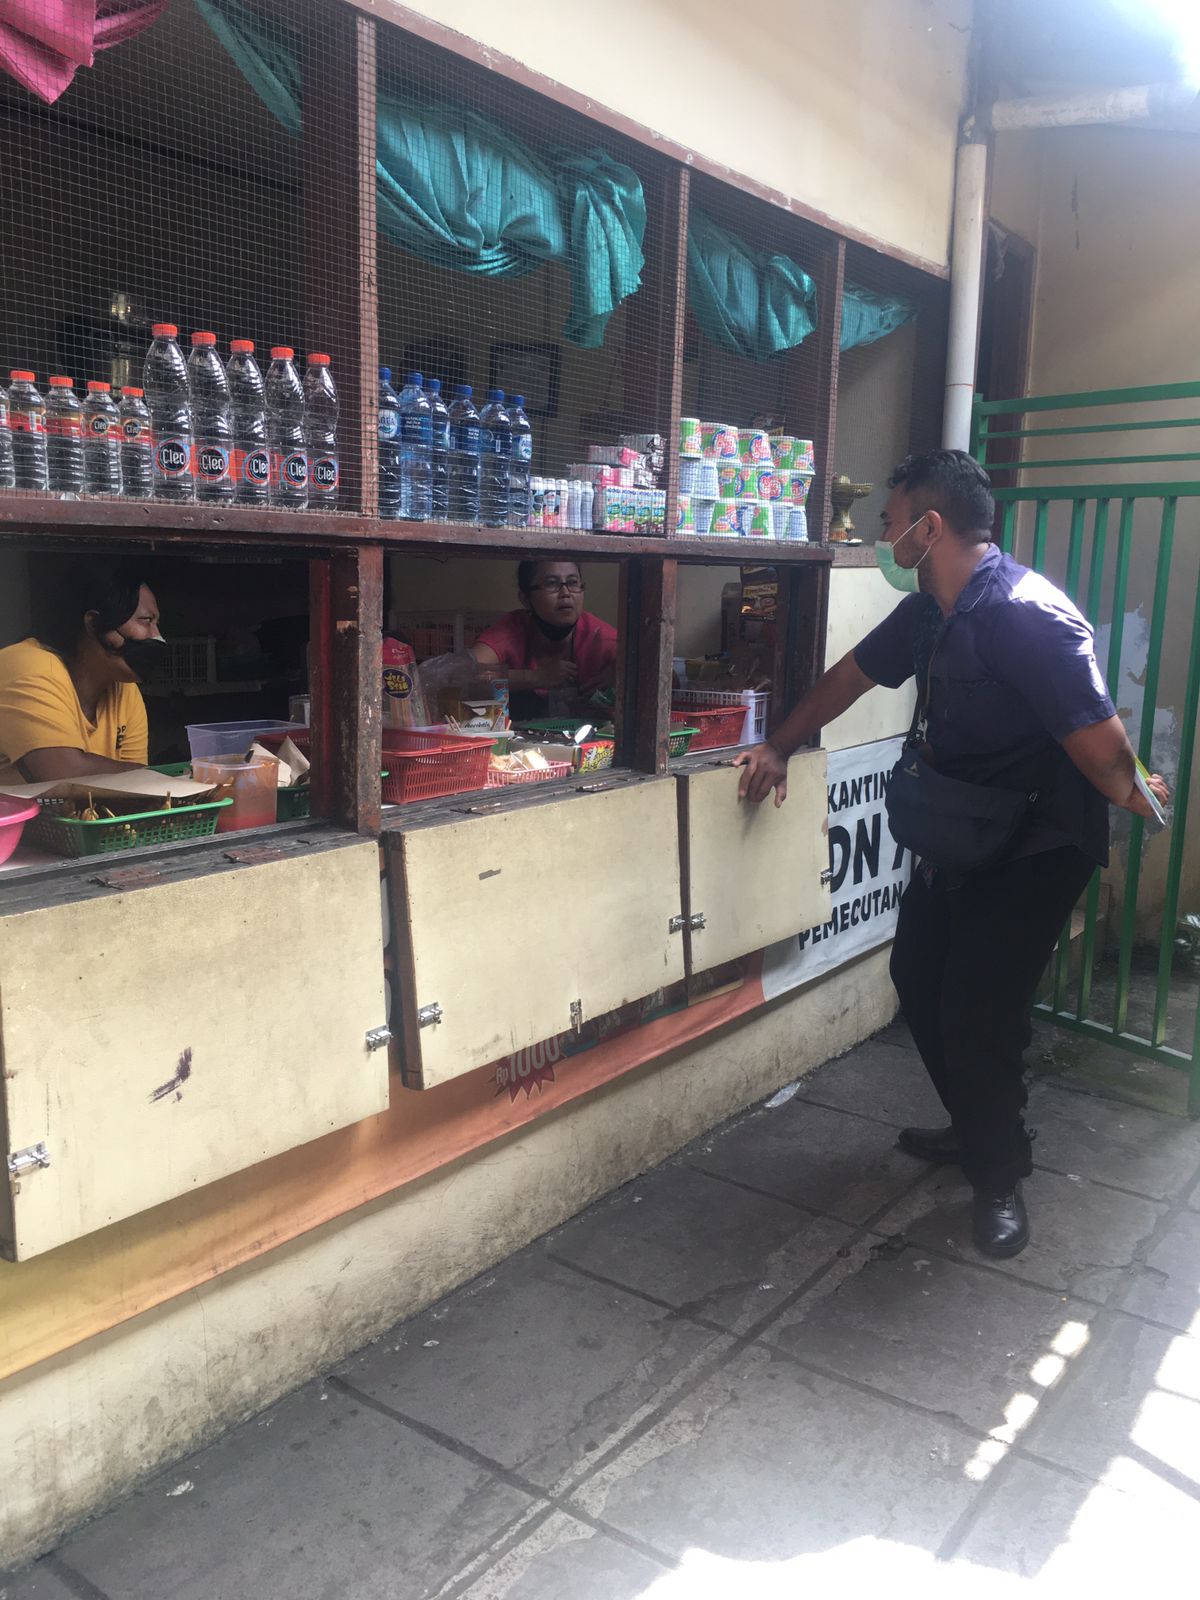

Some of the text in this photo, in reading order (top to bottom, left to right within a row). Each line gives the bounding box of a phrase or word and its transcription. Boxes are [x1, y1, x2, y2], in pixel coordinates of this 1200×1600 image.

[162, 448, 186, 464] Cleo
[202, 455, 224, 470] Cleo
[827, 769, 891, 815] KANTIN
[799, 880, 903, 951] PEMECUTAN
